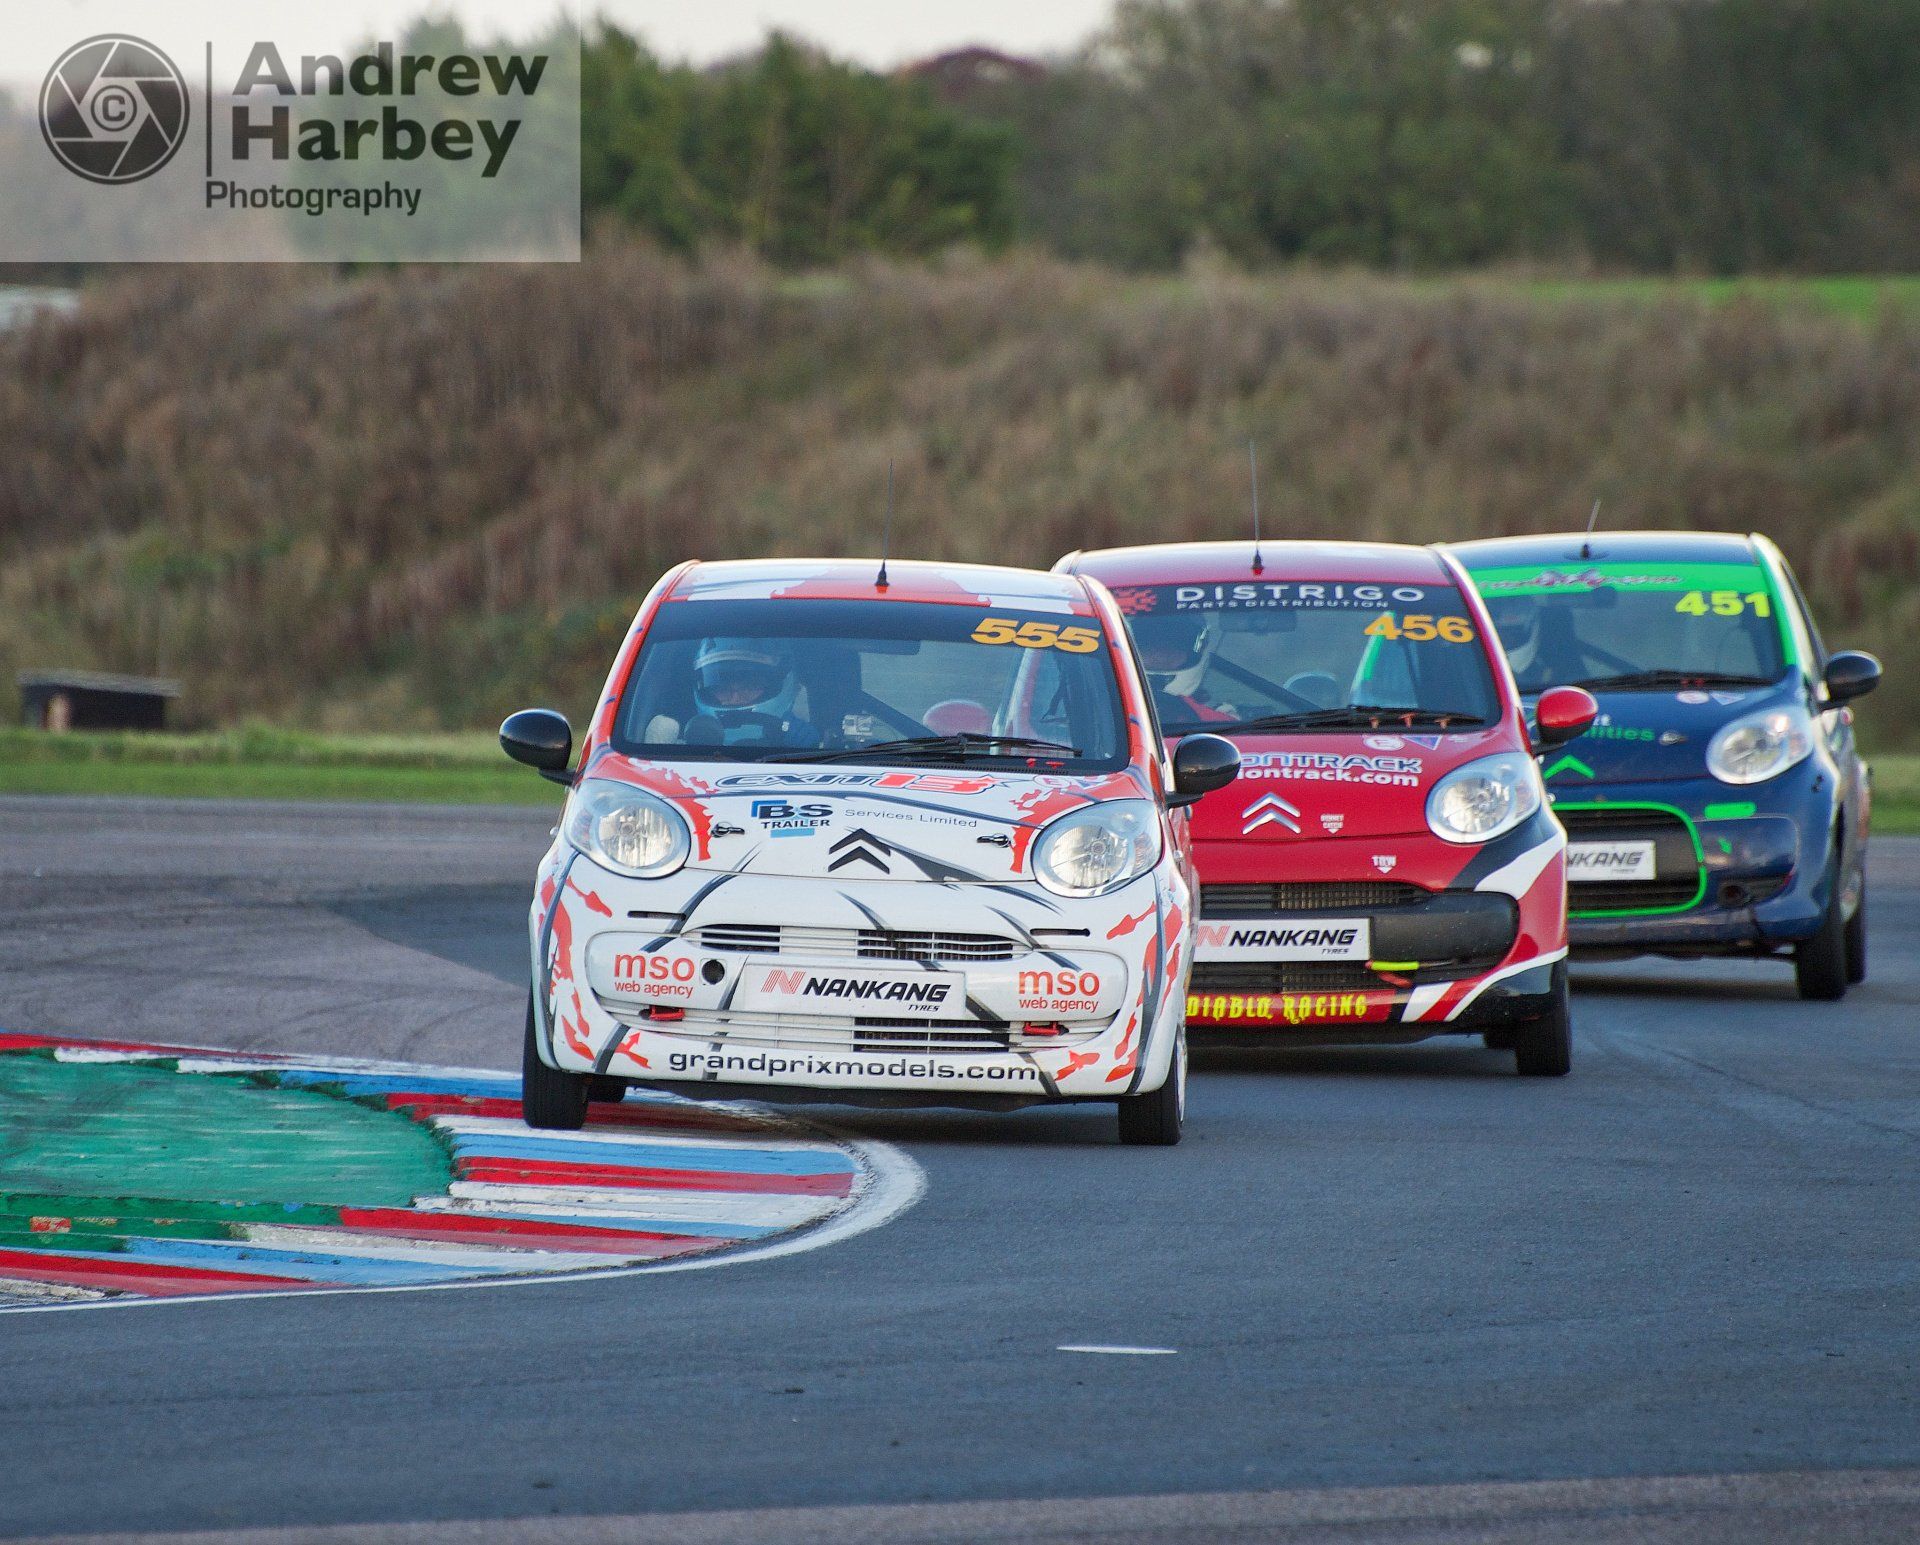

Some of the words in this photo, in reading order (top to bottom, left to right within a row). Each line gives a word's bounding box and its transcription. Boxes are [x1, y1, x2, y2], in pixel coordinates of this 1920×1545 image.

[1176, 585, 1425, 602] DISTRIGO
[1176, 601, 1239, 609] PARTS
[1245, 600, 1389, 608] DISTRIBUTION
[1674, 591, 1771, 618] 451
[971, 618, 1101, 654] 555
[1363, 613, 1474, 644] 456
[1236, 768, 1419, 787] iontrack.com
[761, 819, 831, 829] TRAILER
[845, 808, 913, 821] Services
[919, 814, 978, 829] Limited
[1229, 929, 1358, 948] NANKANG
[613, 954, 695, 981] mso
[614, 982, 640, 993] web
[643, 984, 693, 999] agency
[802, 976, 953, 1003] NANKANG
[1018, 970, 1100, 996] mso
[908, 1004, 940, 1012] TYRES
[1019, 998, 1045, 1010] web
[1049, 999, 1099, 1013] agency
[1282, 995, 1367, 1024] RACING
[669, 1053, 1039, 1081] grandprixmodels.com
